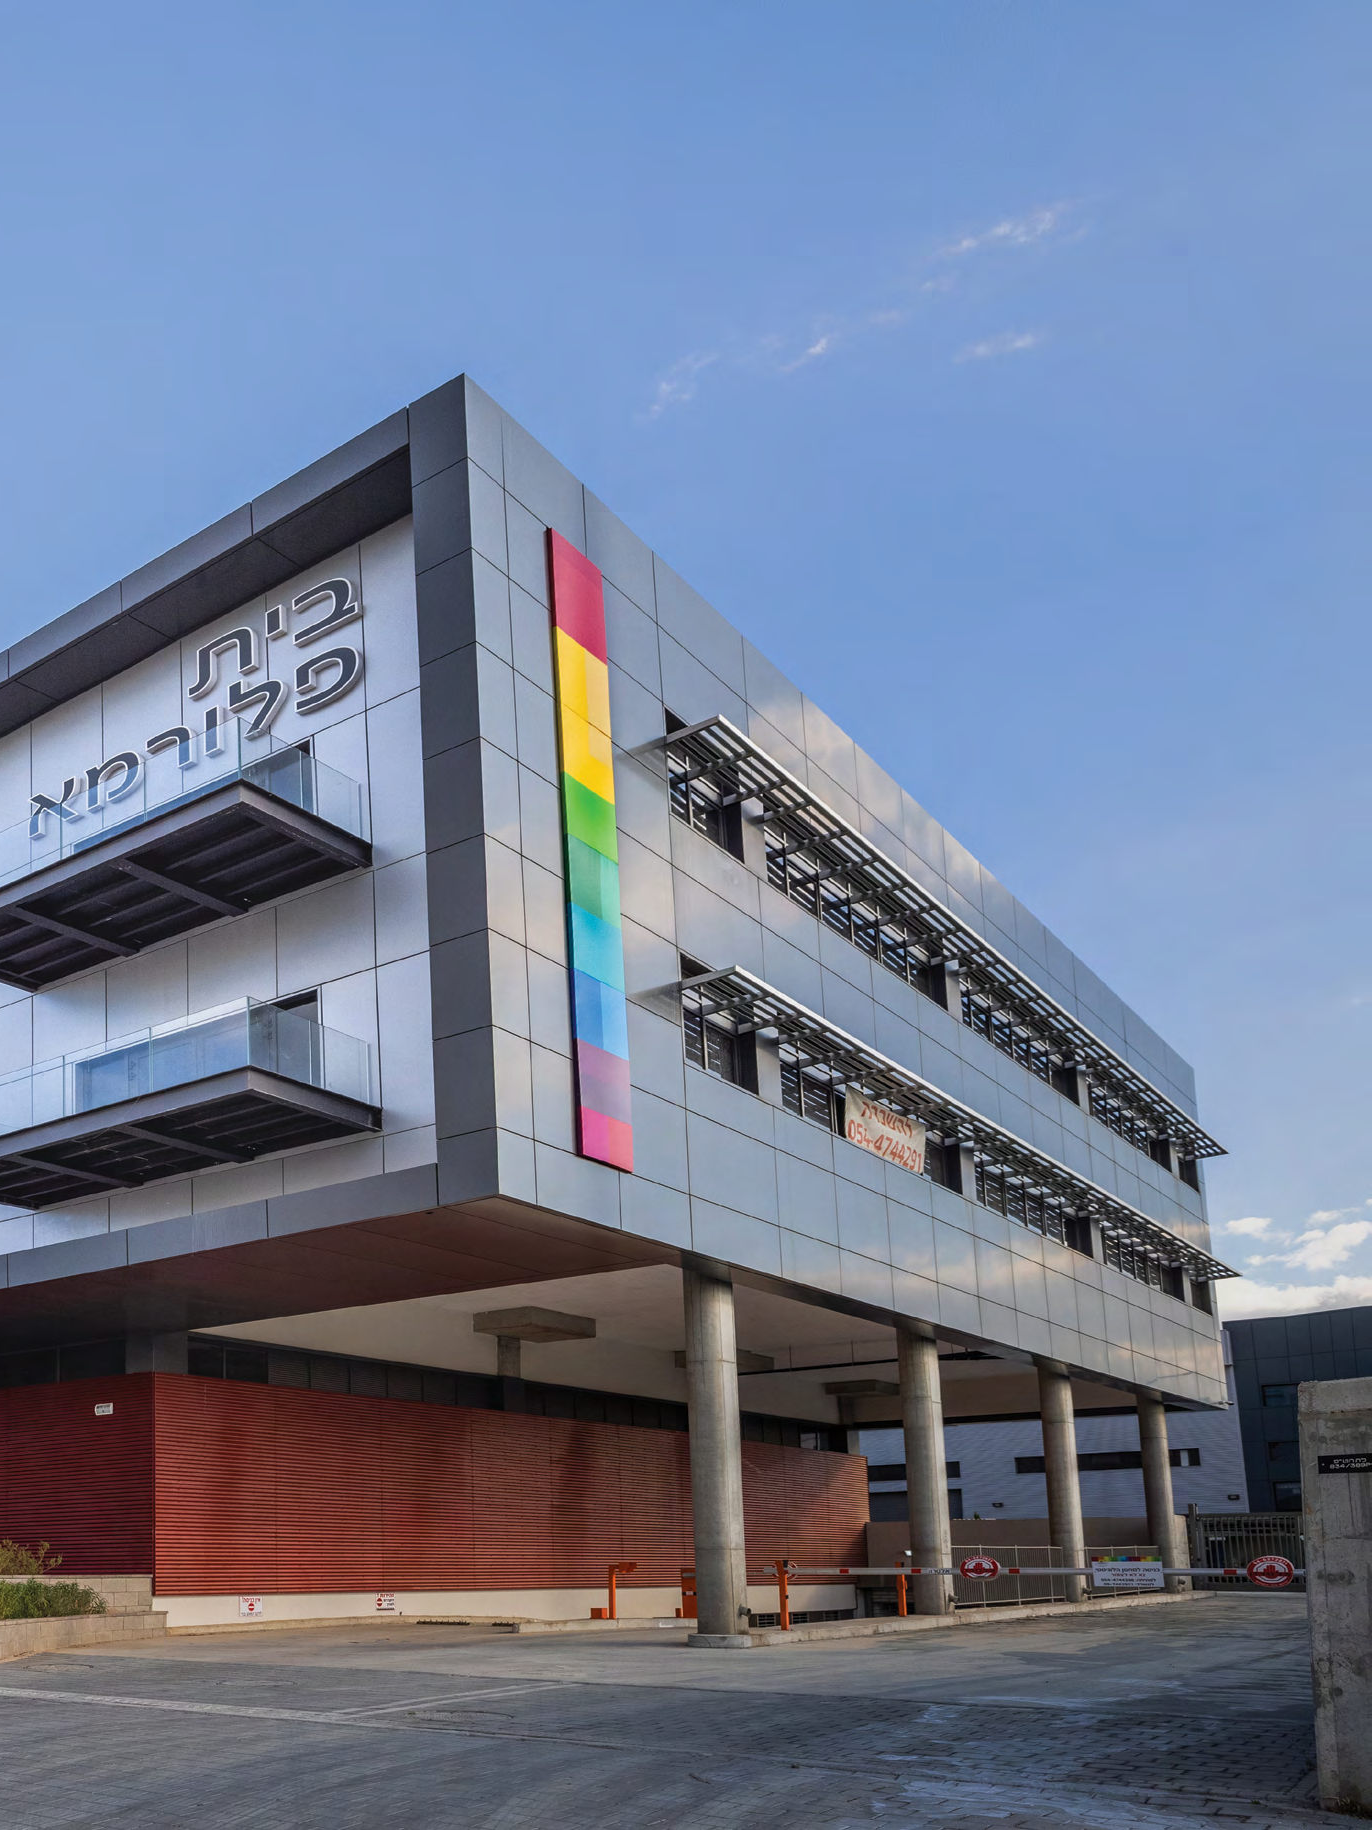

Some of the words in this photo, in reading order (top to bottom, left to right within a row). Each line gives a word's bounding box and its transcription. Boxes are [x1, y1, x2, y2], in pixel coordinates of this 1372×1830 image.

[187, 577, 364, 700] בית
[28, 646, 364, 840] פלורמא
[847, 1119, 923, 1173] 054-4744291
[861, 1100, 913, 1138] להשכרה
